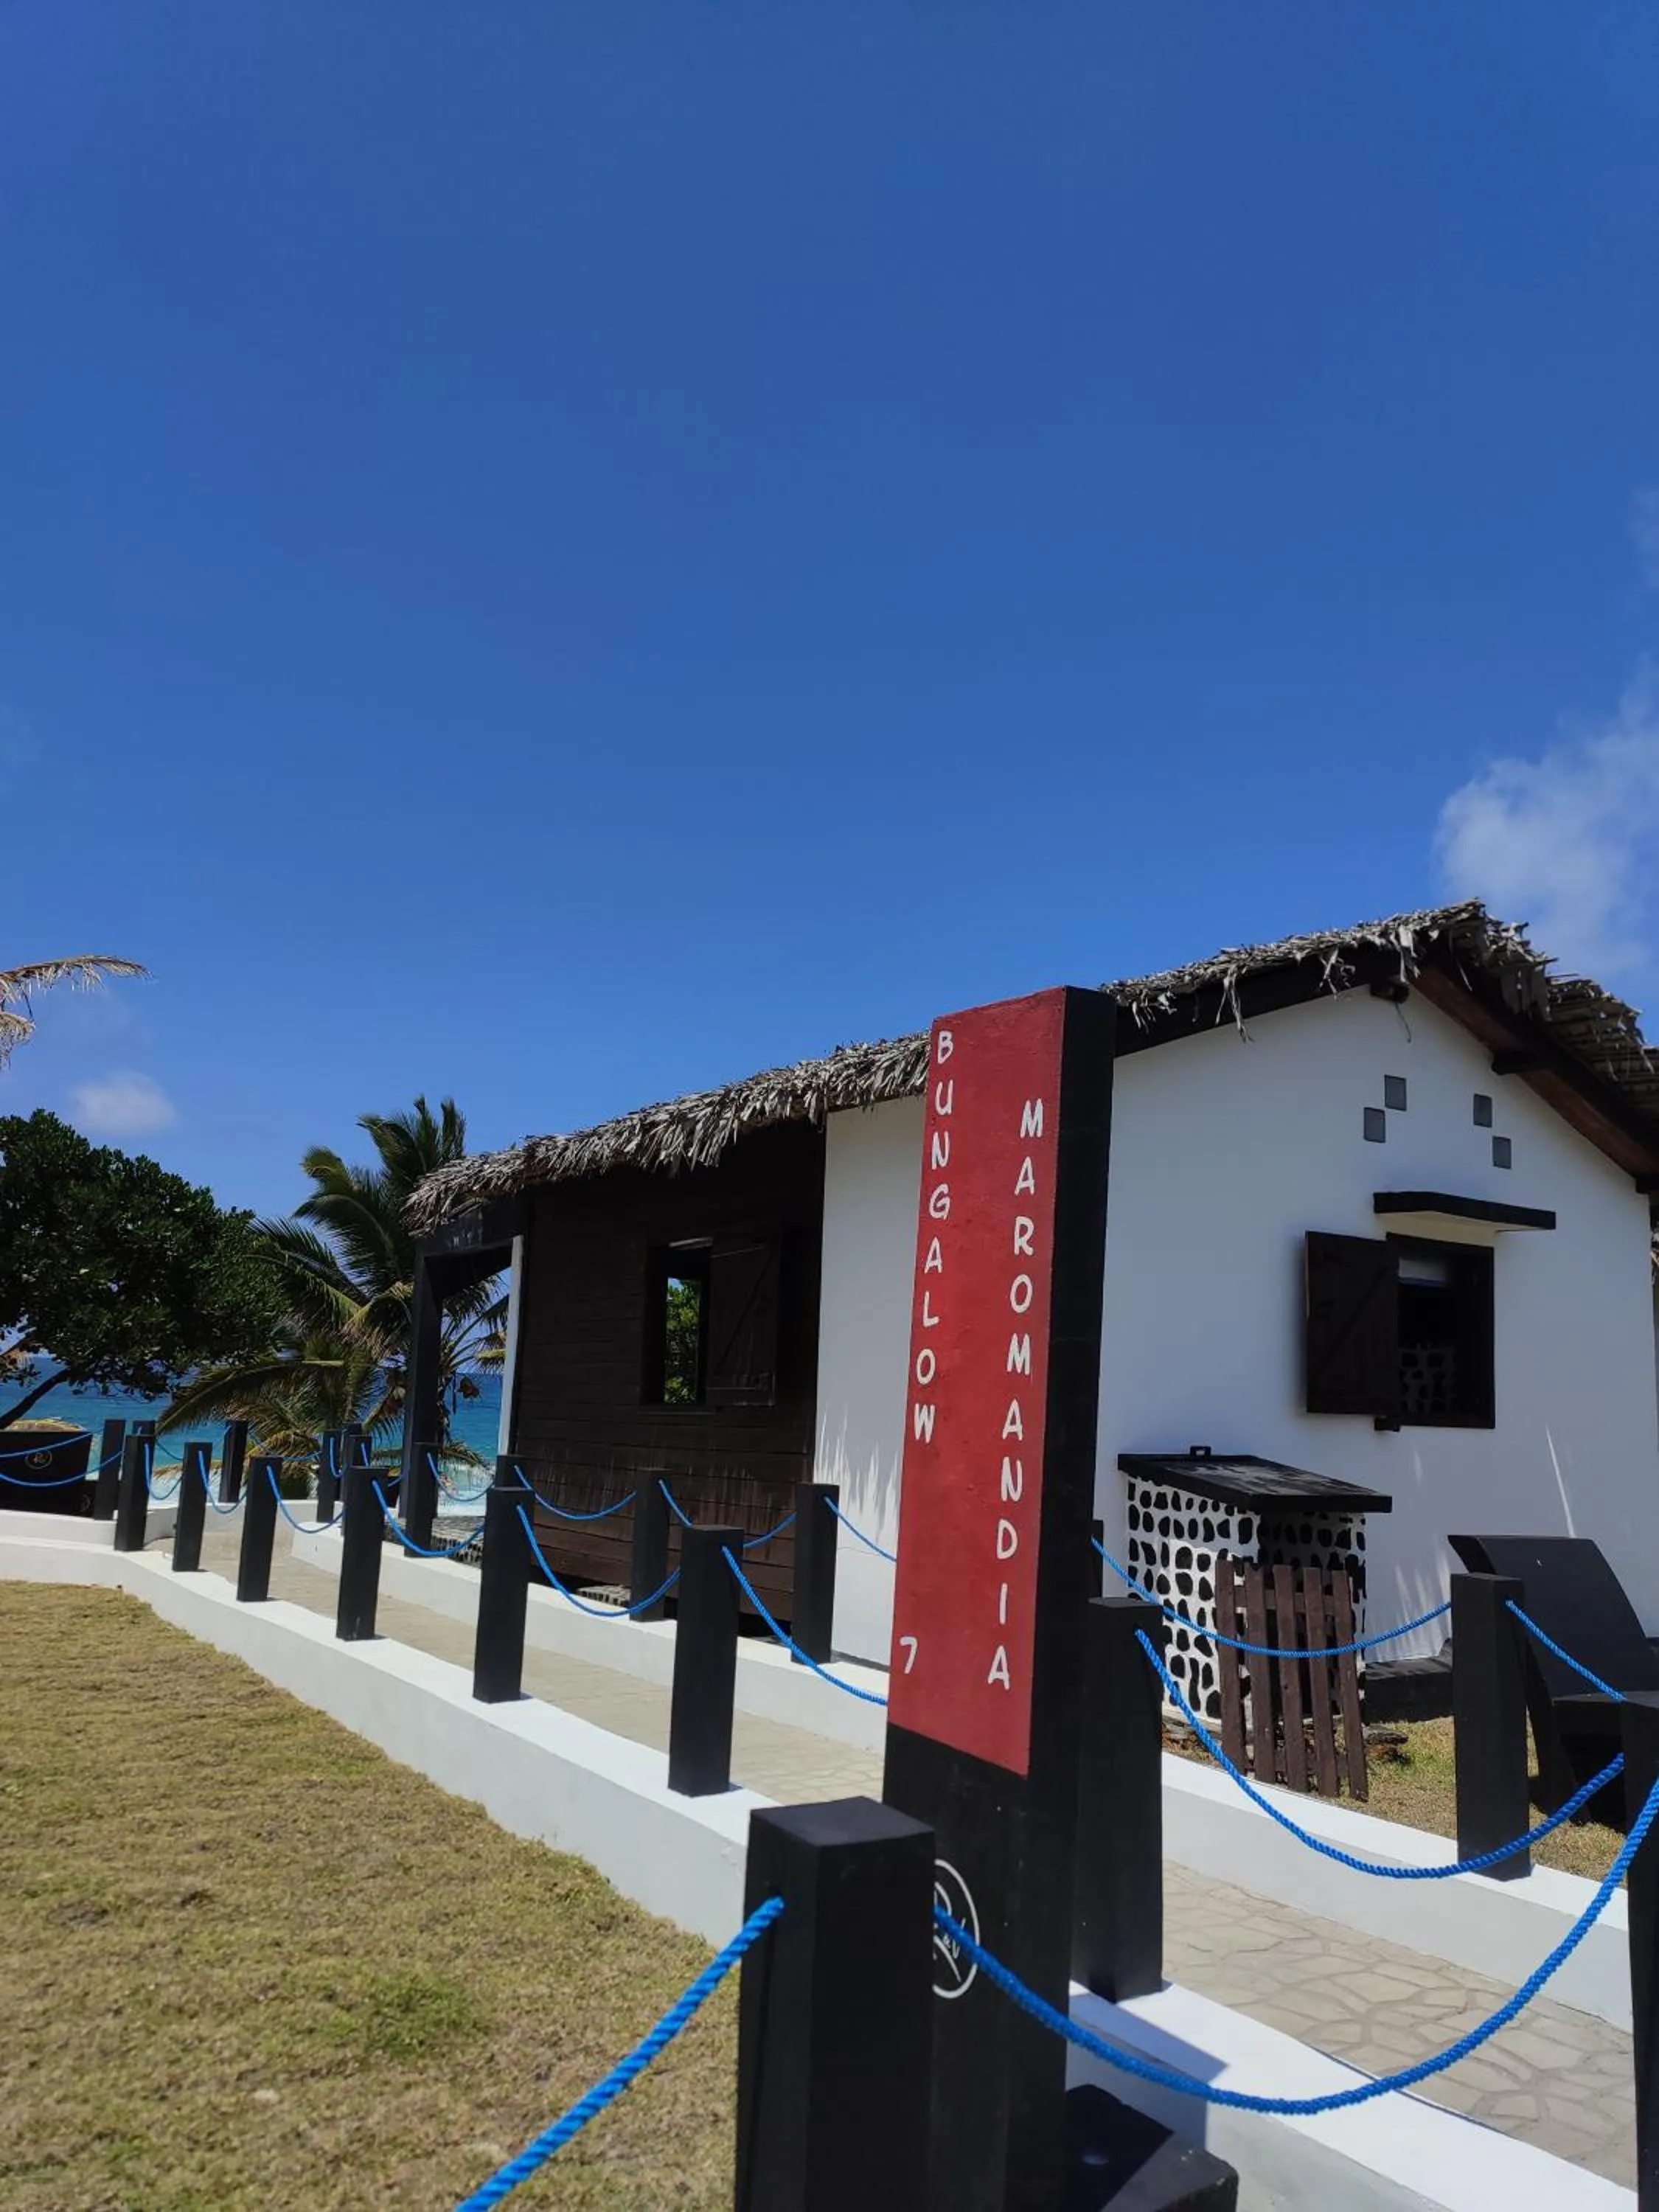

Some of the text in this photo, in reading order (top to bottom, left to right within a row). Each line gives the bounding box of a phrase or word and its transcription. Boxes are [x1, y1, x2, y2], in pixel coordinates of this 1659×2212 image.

[914, 1031, 953, 1443] BUNGALOW
[987, 1098, 1043, 1690] MAROMANDIA
[900, 1636, 918, 1674] 7
